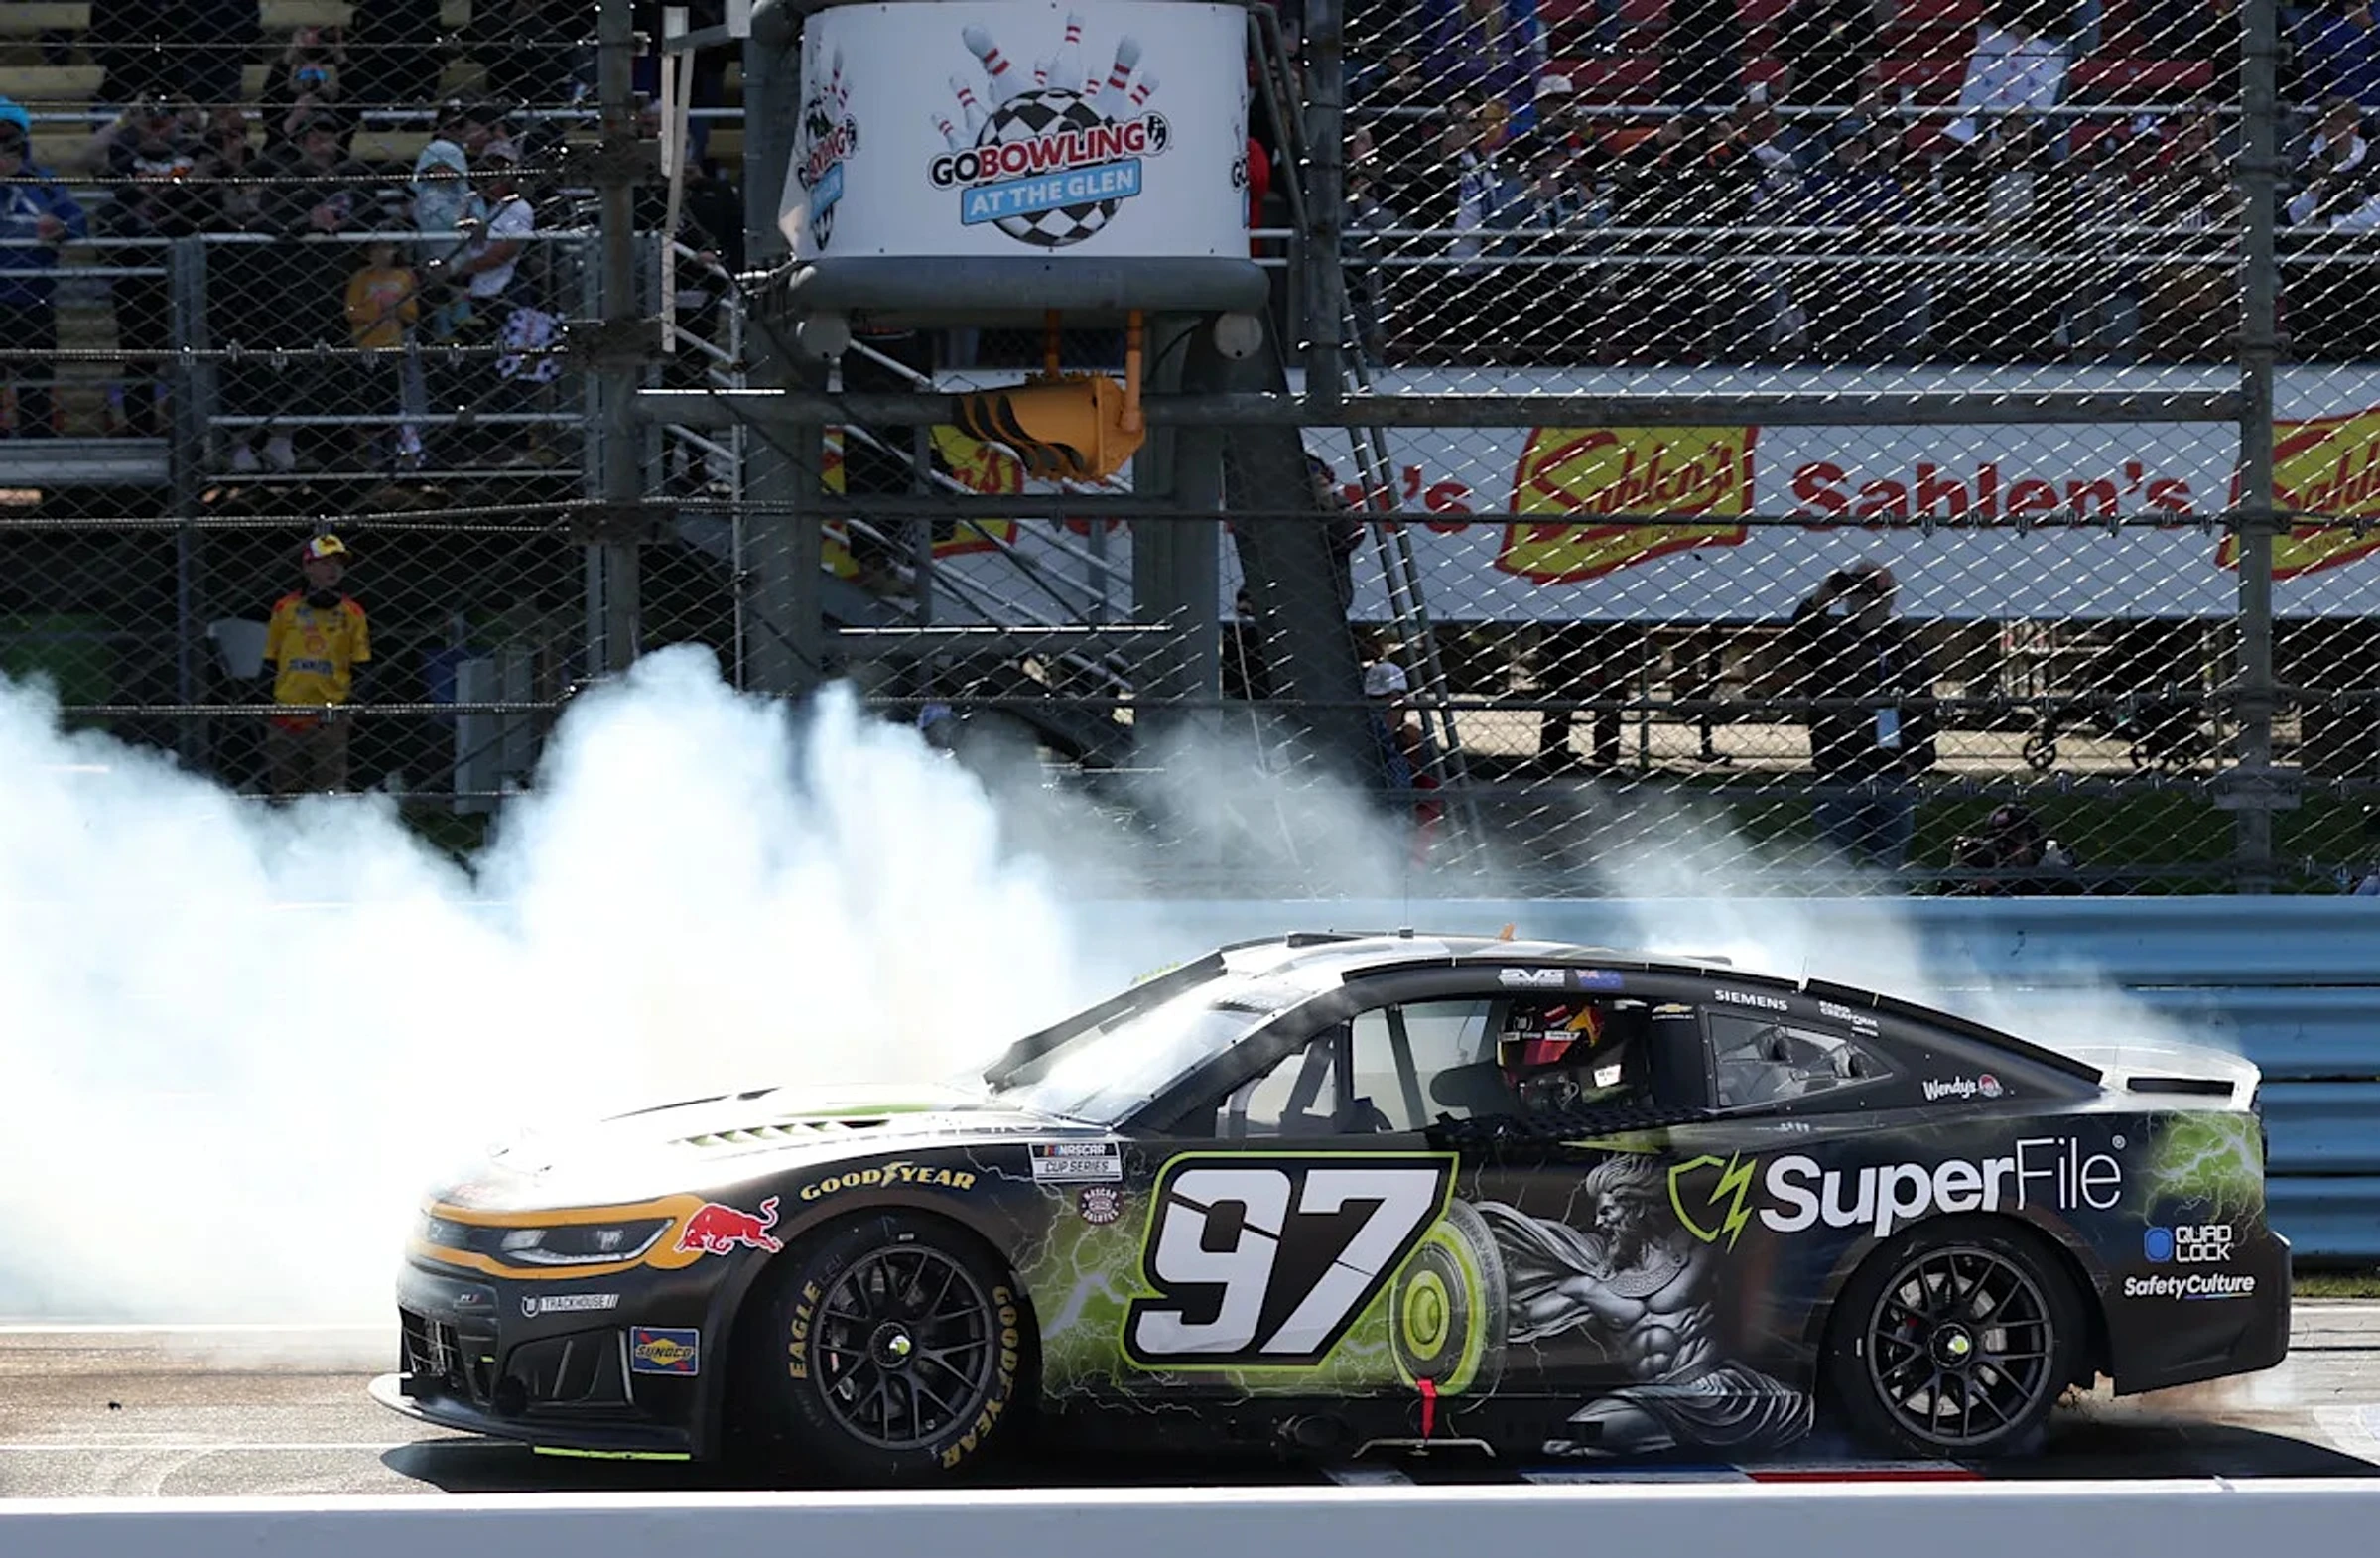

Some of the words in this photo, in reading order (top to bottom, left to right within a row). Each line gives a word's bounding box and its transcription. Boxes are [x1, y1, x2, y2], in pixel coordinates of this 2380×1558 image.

[932, 122, 1144, 186] GOBOWLING
[969, 190, 1007, 216] AT
[1008, 178, 1064, 208] THE
[1067, 167, 1134, 198] GLEN
[1791, 461, 2194, 531] Sahlen's
[1714, 990, 1788, 1011] SIEMENS
[1922, 1076, 1976, 1101] Wendy's
[1045, 1161, 1069, 1172] CUP
[1071, 1161, 1110, 1172] SERIES
[1056, 1144, 1107, 1157] NASCAR
[799, 1160, 976, 1201] GOODYEAR
[2175, 1224, 2232, 1244] QUAD
[1135, 1169, 1439, 1353] 97
[2175, 1243, 2231, 1263] LOCK
[788, 1279, 822, 1379] EAGLE
[636, 1344, 693, 1358] SUNOCO
[941, 1284, 1019, 1470] GOODYEAR
